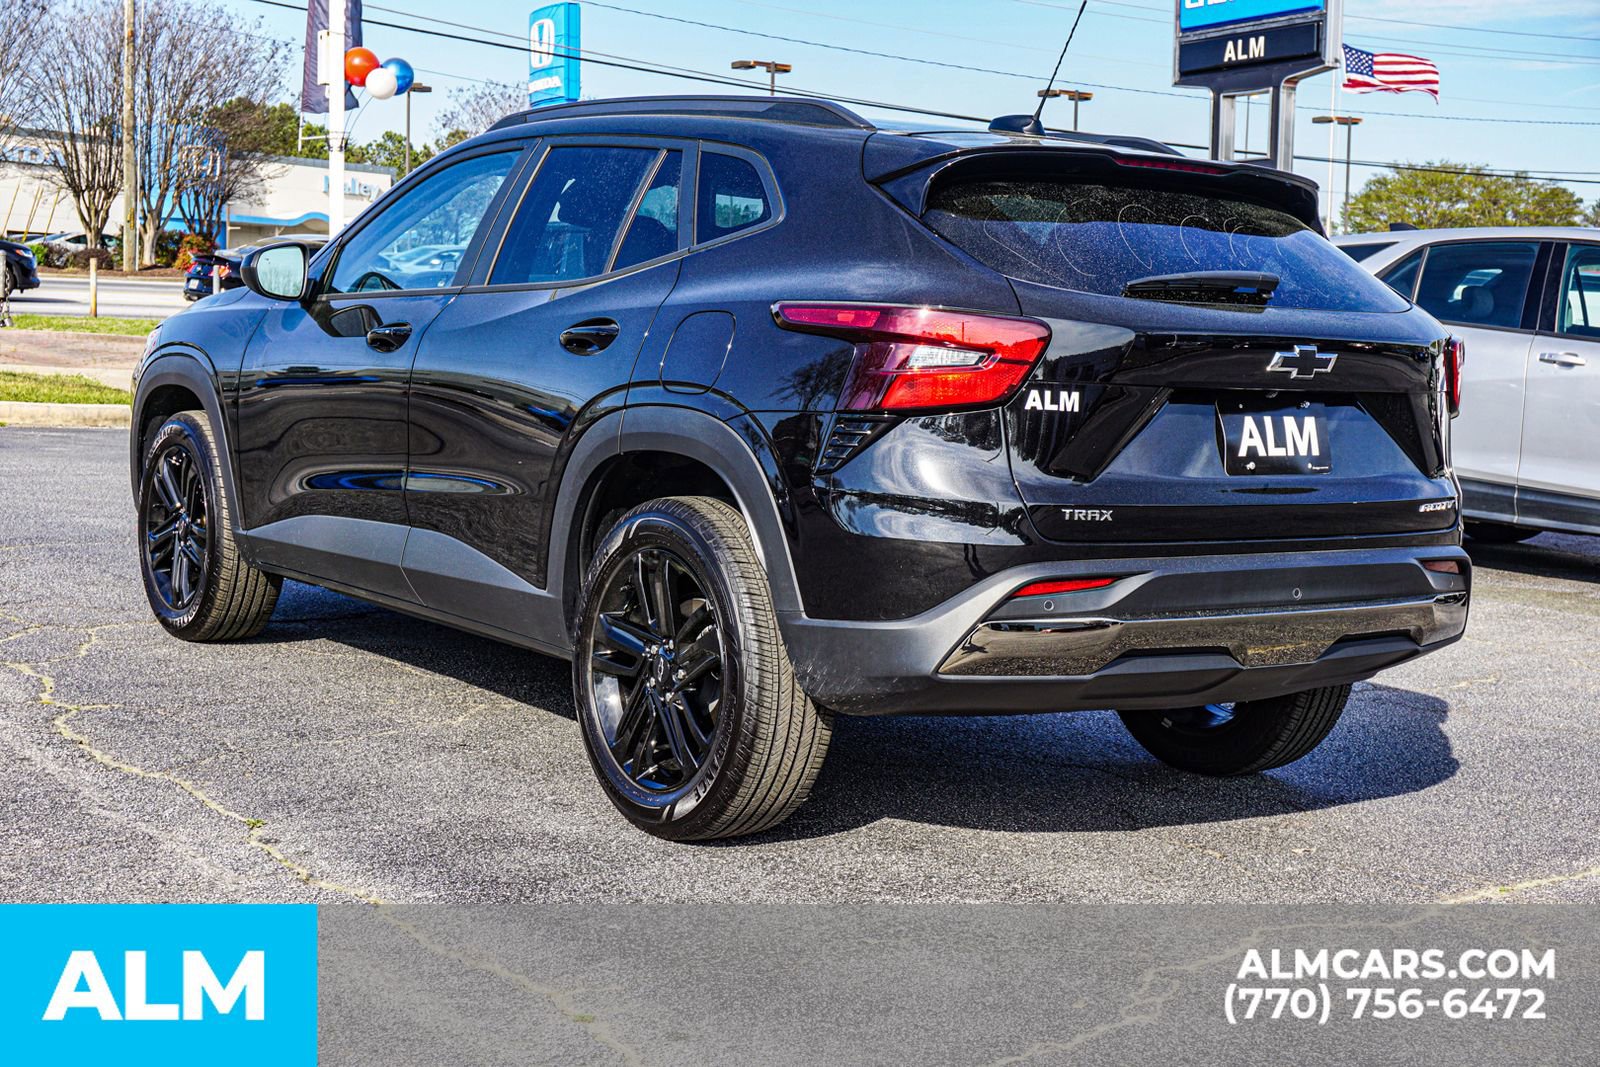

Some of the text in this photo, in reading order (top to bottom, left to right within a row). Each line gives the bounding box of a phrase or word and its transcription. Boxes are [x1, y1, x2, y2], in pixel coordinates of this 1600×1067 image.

[1224, 35, 1266, 63] ALM
[1025, 390, 1080, 413] ALM
[1237, 416, 1320, 457] ALM
[1061, 508, 1114, 521] TRAX
